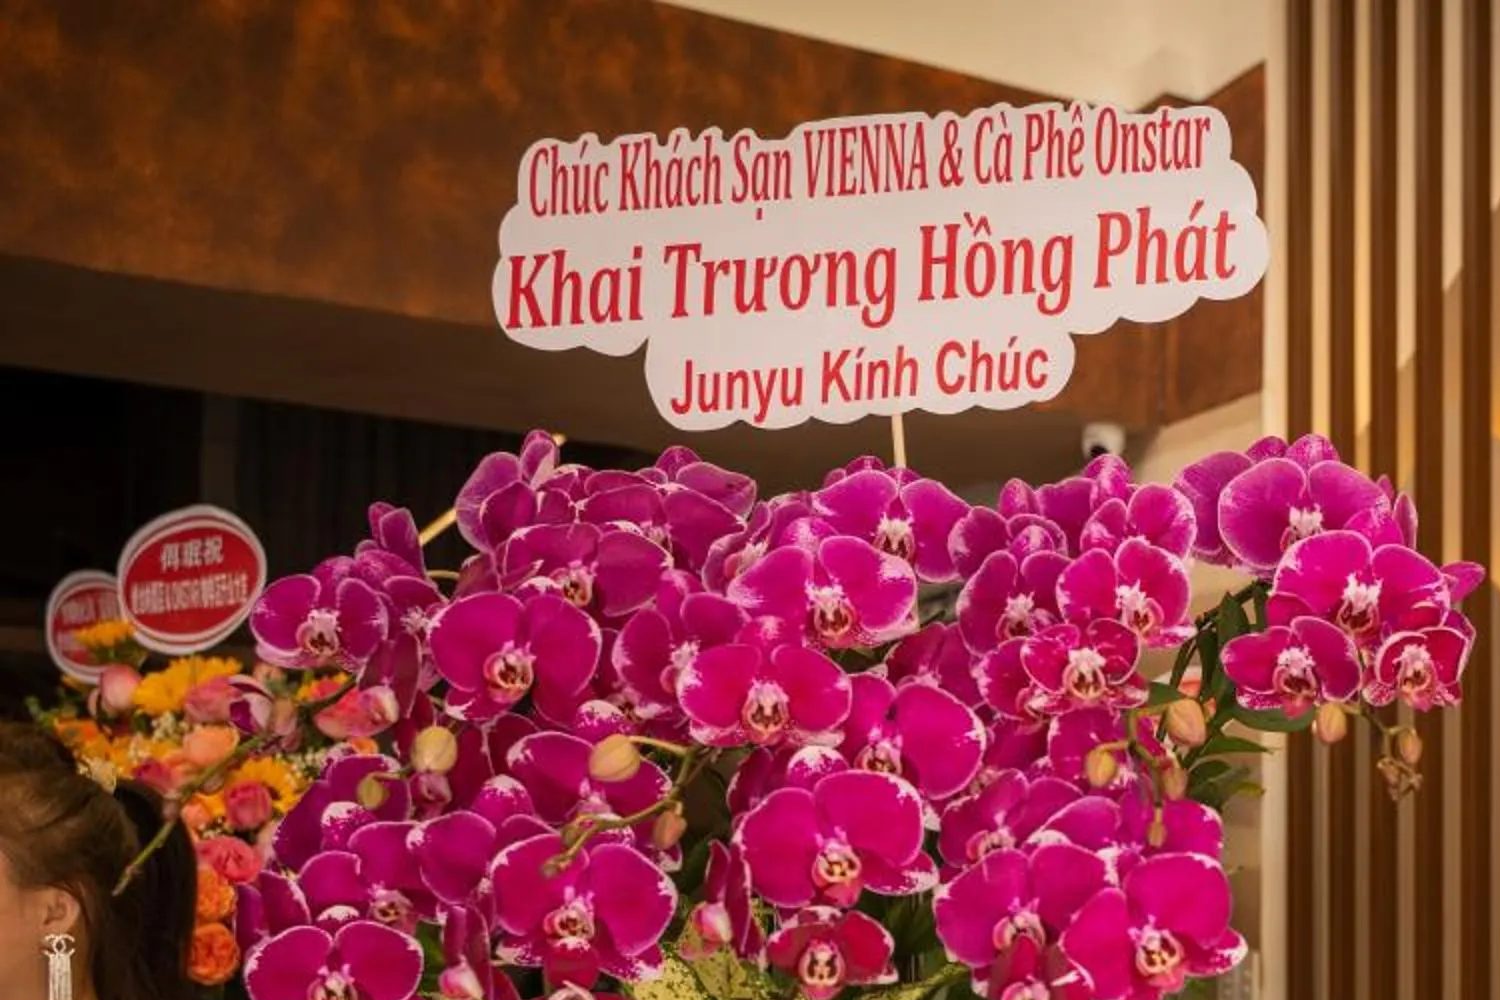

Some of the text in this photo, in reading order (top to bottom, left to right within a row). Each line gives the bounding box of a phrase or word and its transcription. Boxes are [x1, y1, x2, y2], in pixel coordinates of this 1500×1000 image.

[528, 101, 1212, 221] Chúc Khách Sạn VIENNA & Cà Phê Onstar
[503, 198, 1238, 331] Khai Trương Hồng Phát
[670, 338, 1050, 426] Junyu Kính Chúc
